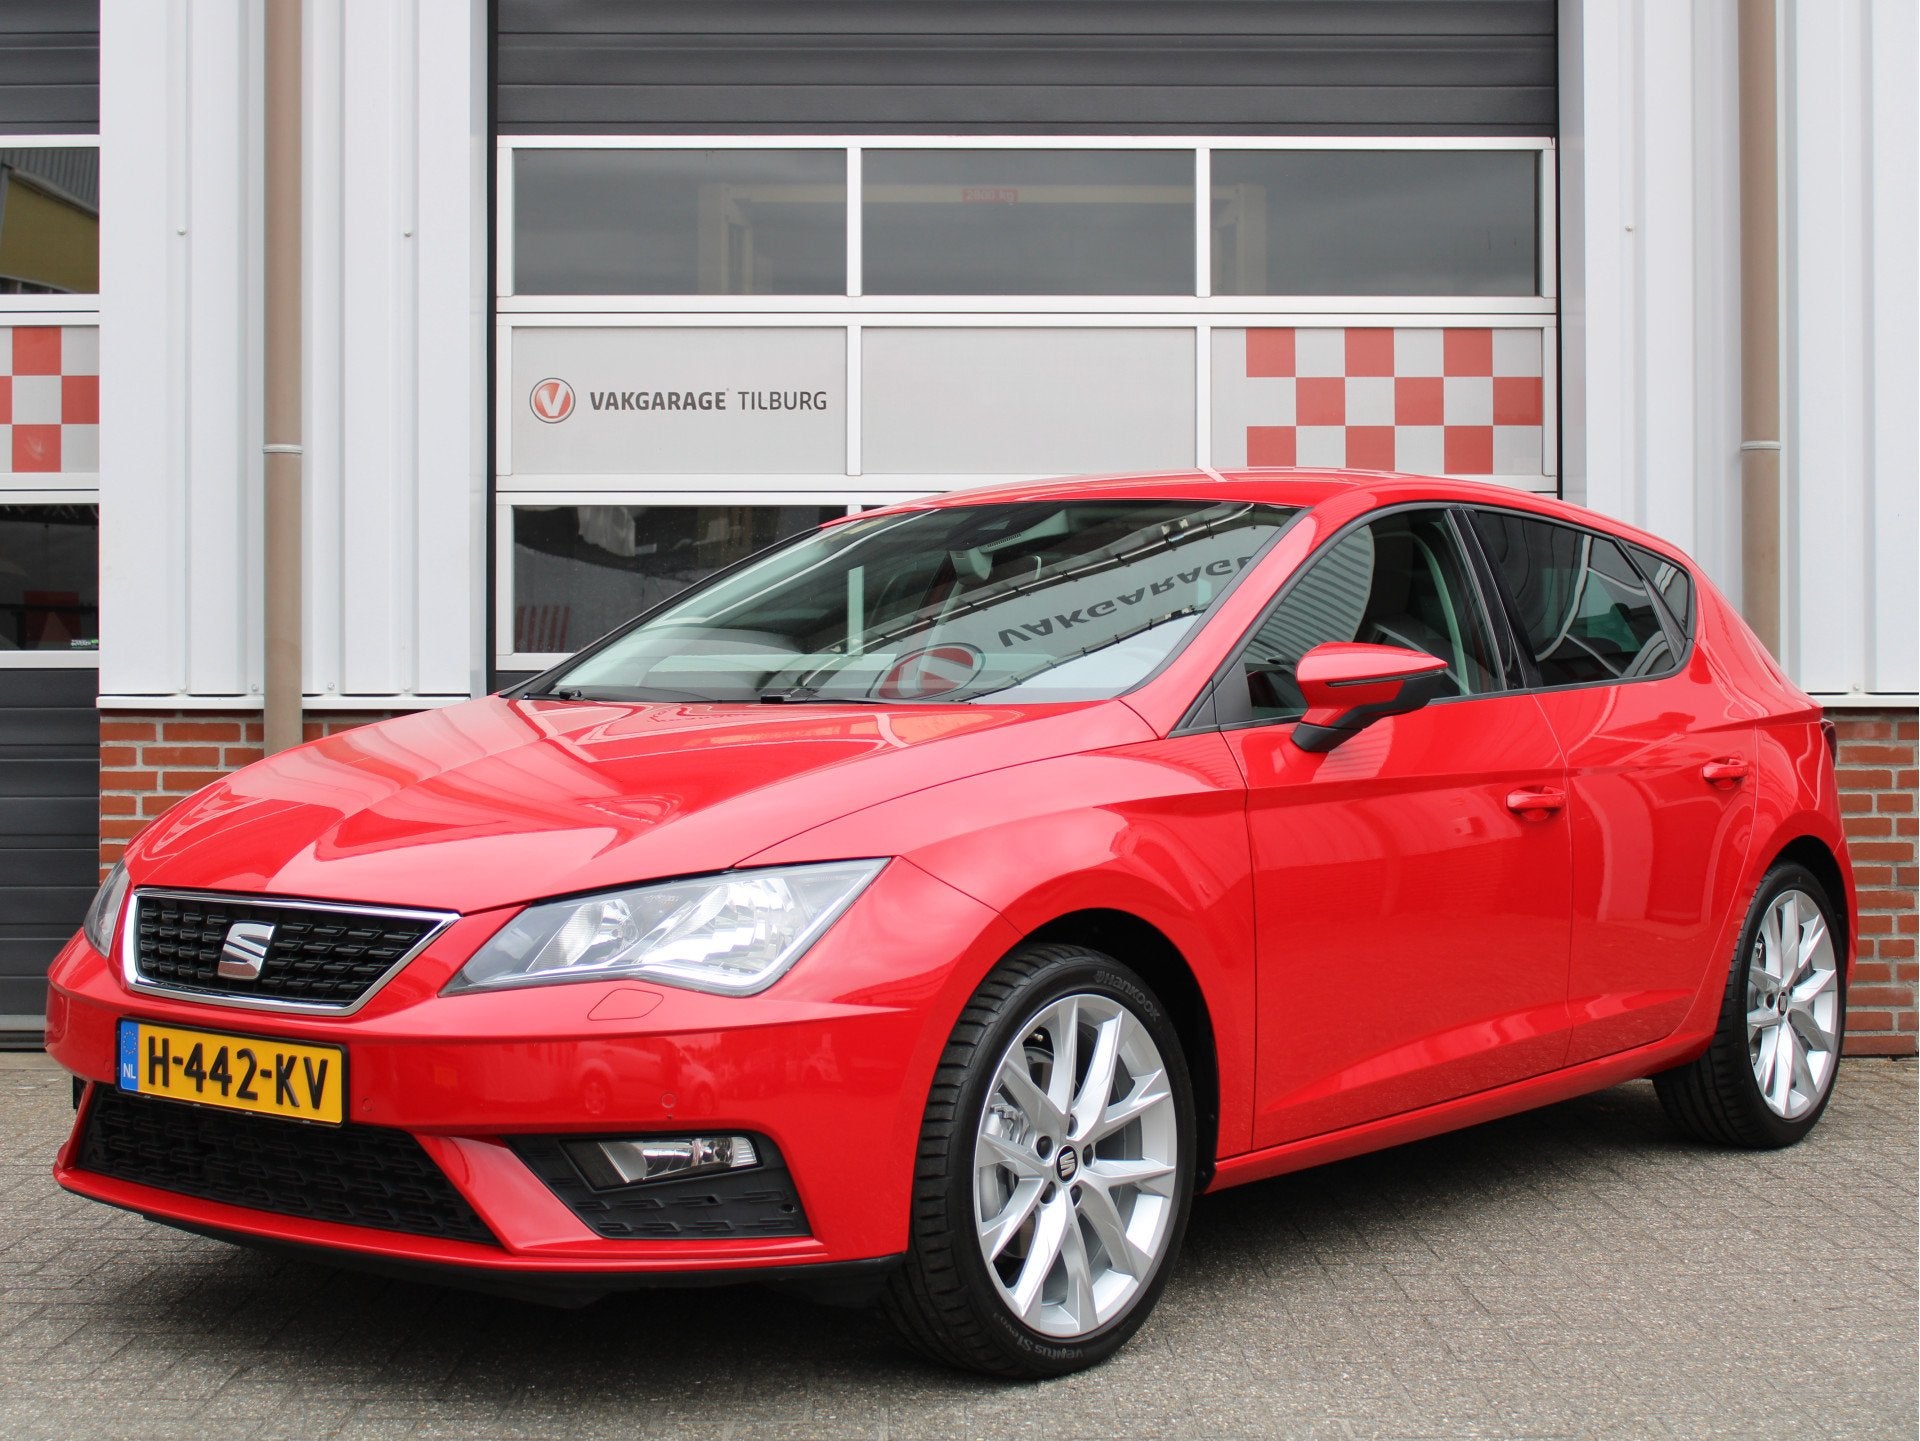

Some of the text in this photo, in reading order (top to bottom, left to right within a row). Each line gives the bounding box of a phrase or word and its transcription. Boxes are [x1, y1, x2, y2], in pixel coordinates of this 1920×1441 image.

[590, 391, 827, 410] VAKGARAGE TILBURG
[122, 1062, 137, 1079] NL
[148, 1036, 328, 1110] H-442-KV
